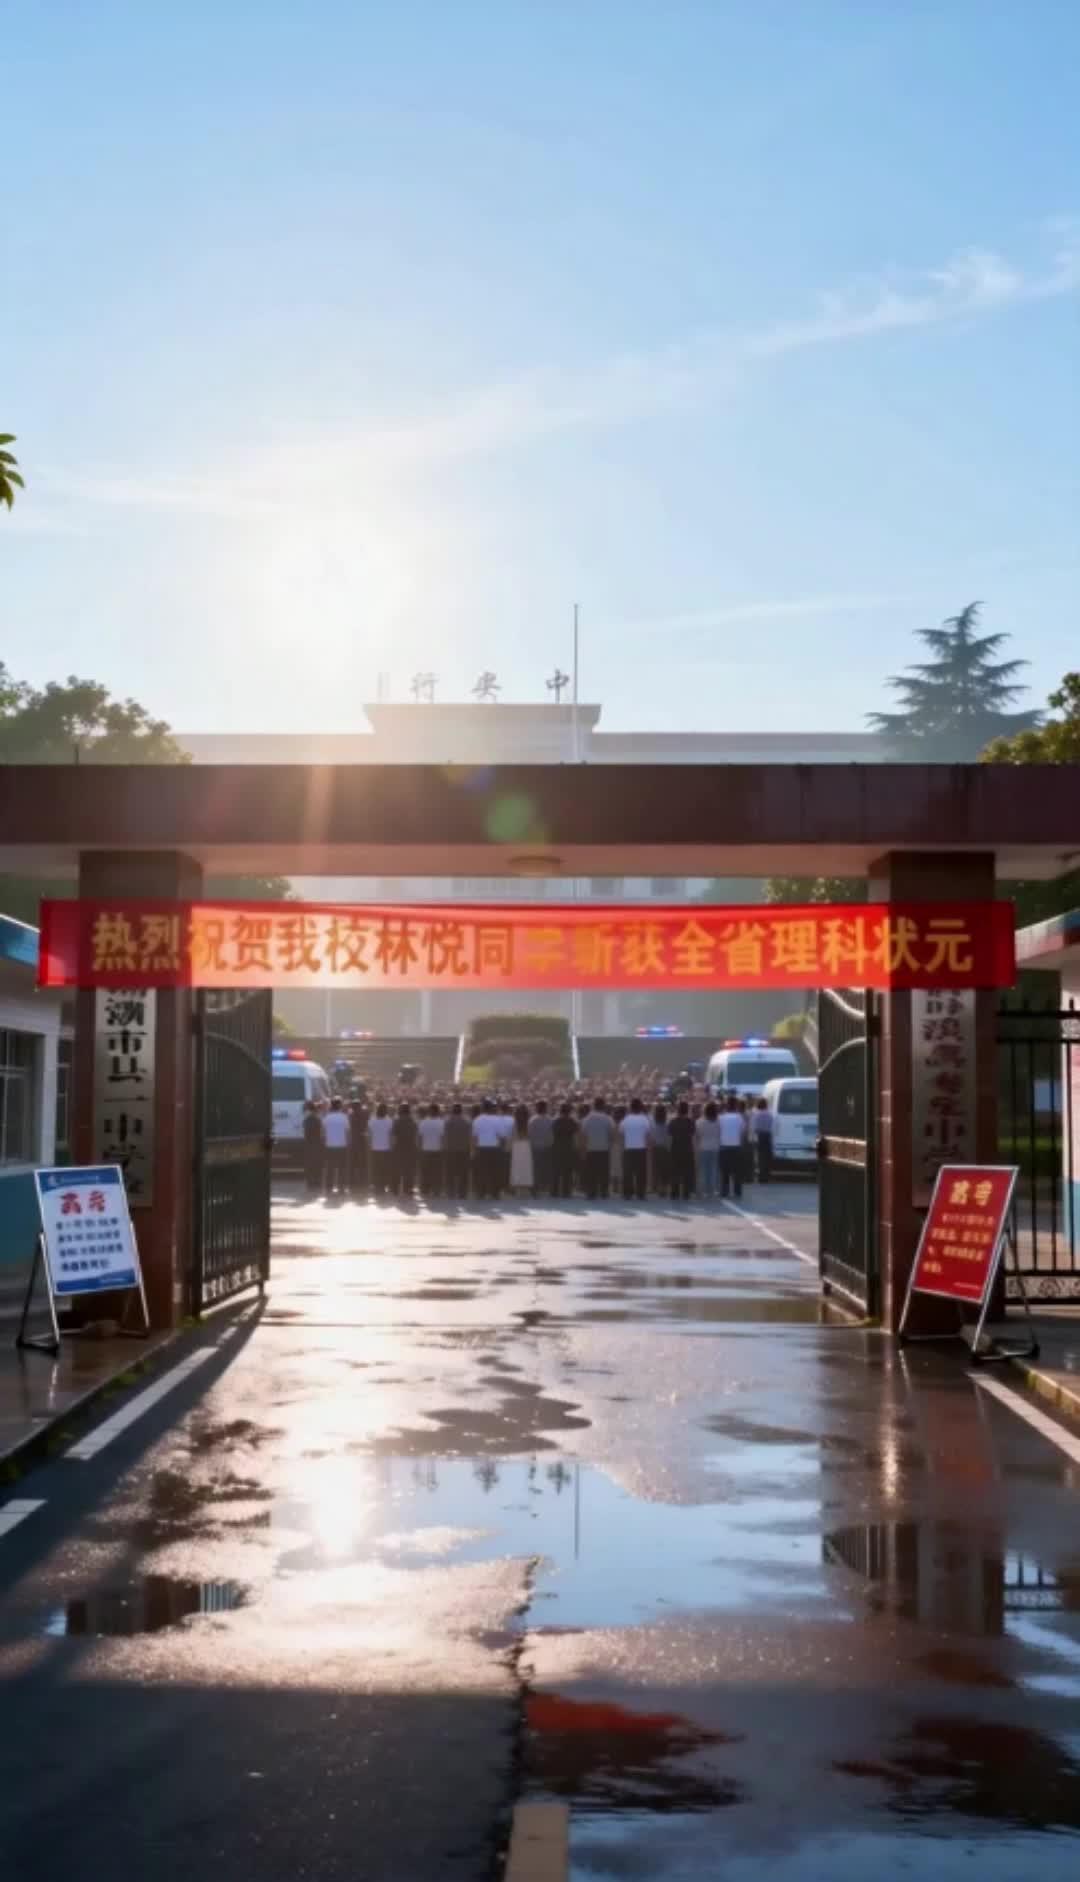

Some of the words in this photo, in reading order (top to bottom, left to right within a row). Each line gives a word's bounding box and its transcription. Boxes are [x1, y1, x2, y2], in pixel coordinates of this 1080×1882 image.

[91, 912, 973, 976] 热烈祝贺我校林悦同获全省理科状元
